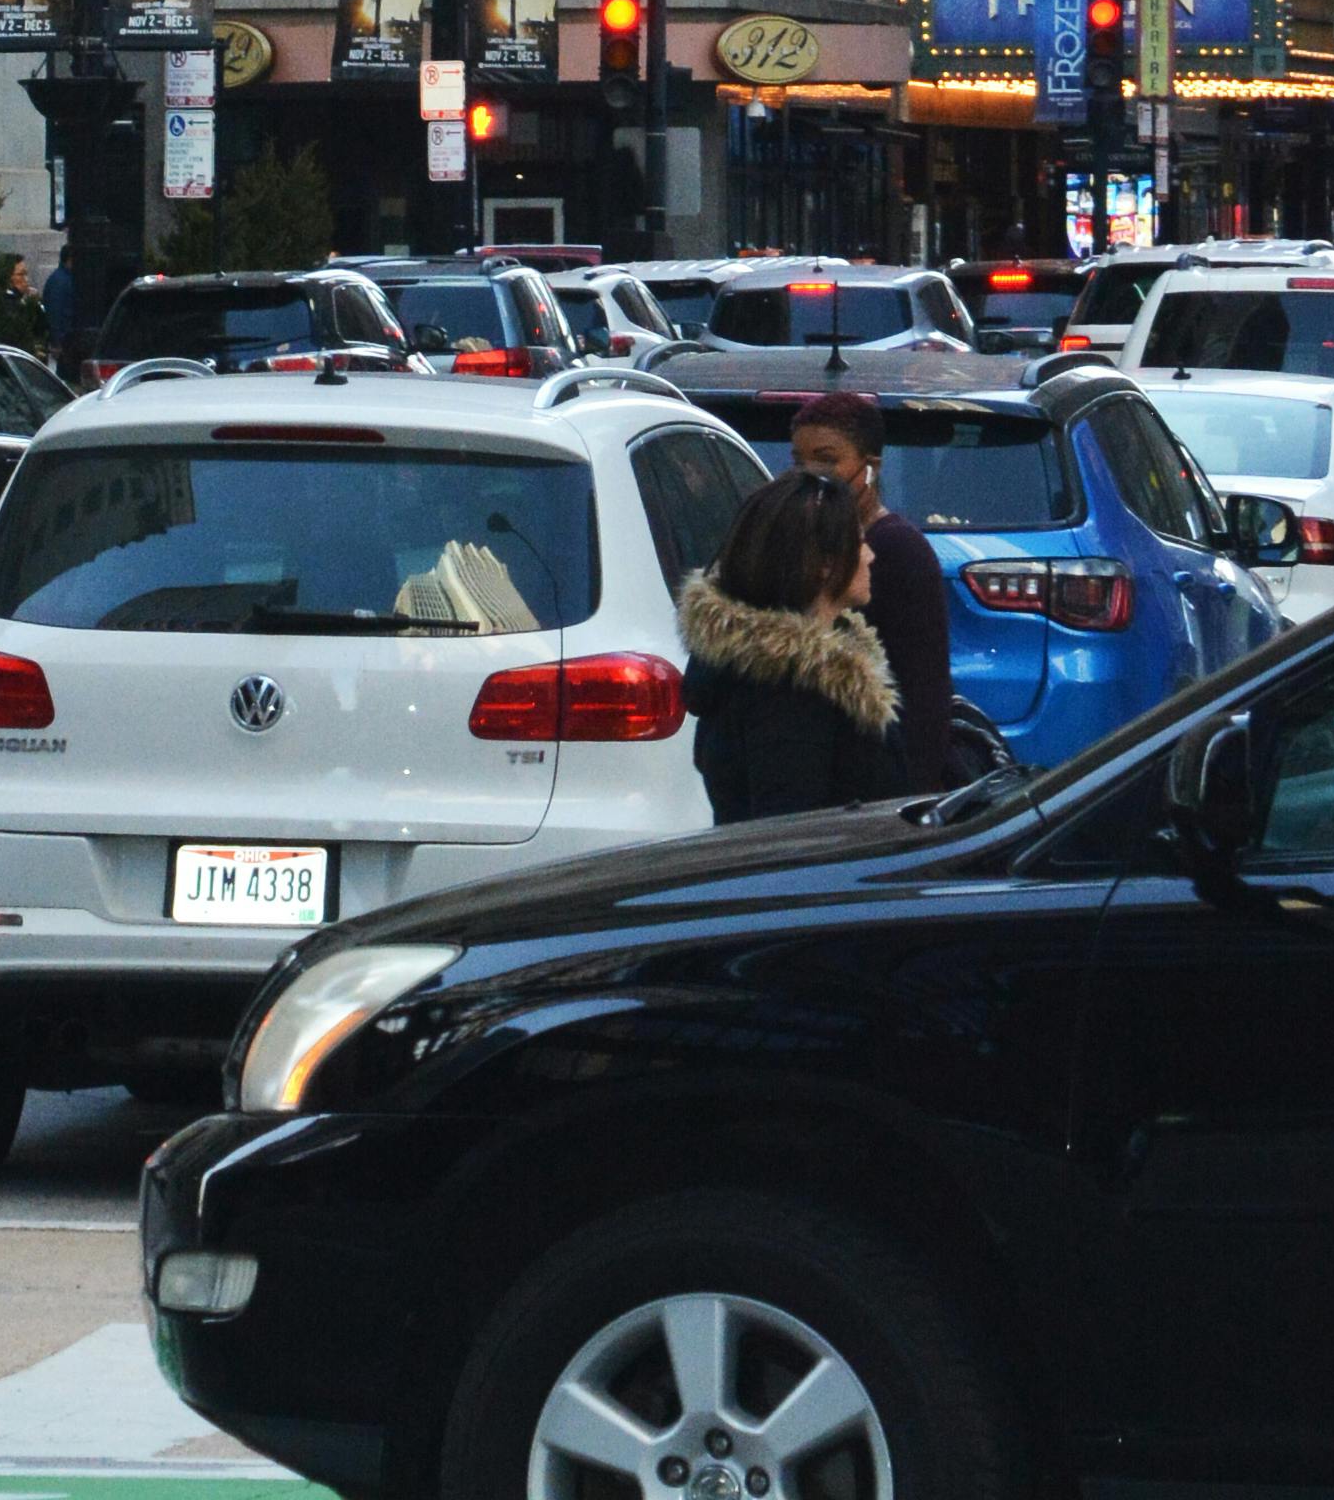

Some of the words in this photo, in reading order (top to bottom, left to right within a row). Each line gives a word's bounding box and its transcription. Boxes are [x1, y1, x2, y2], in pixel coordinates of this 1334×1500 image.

[8, 20, 14, 31] 2
[24, 20, 43, 31] DEC
[44, 20, 51, 31] 5
[128, 16, 147, 27] NOV
[148, 16, 155, 27] 2
[165, 16, 184, 27] DEC
[185, 16, 192, 27] 5
[731, 26, 809, 69] 312
[349, 50, 366, 60] NOV
[367, 50, 373, 60] 2
[381, 50, 397, 61] DEC
[398, 50, 404, 61] 5
[485, 51, 502, 61] NOV
[503, 51, 509, 61] 2
[517, 51, 533, 62] DEC
[534, 51, 540, 62] 5
[506, 750, 545, 765] TSI
[233, 850, 271, 863] OHIO
[187, 866, 236, 901] JIM
[246, 866, 312, 903] 4338
